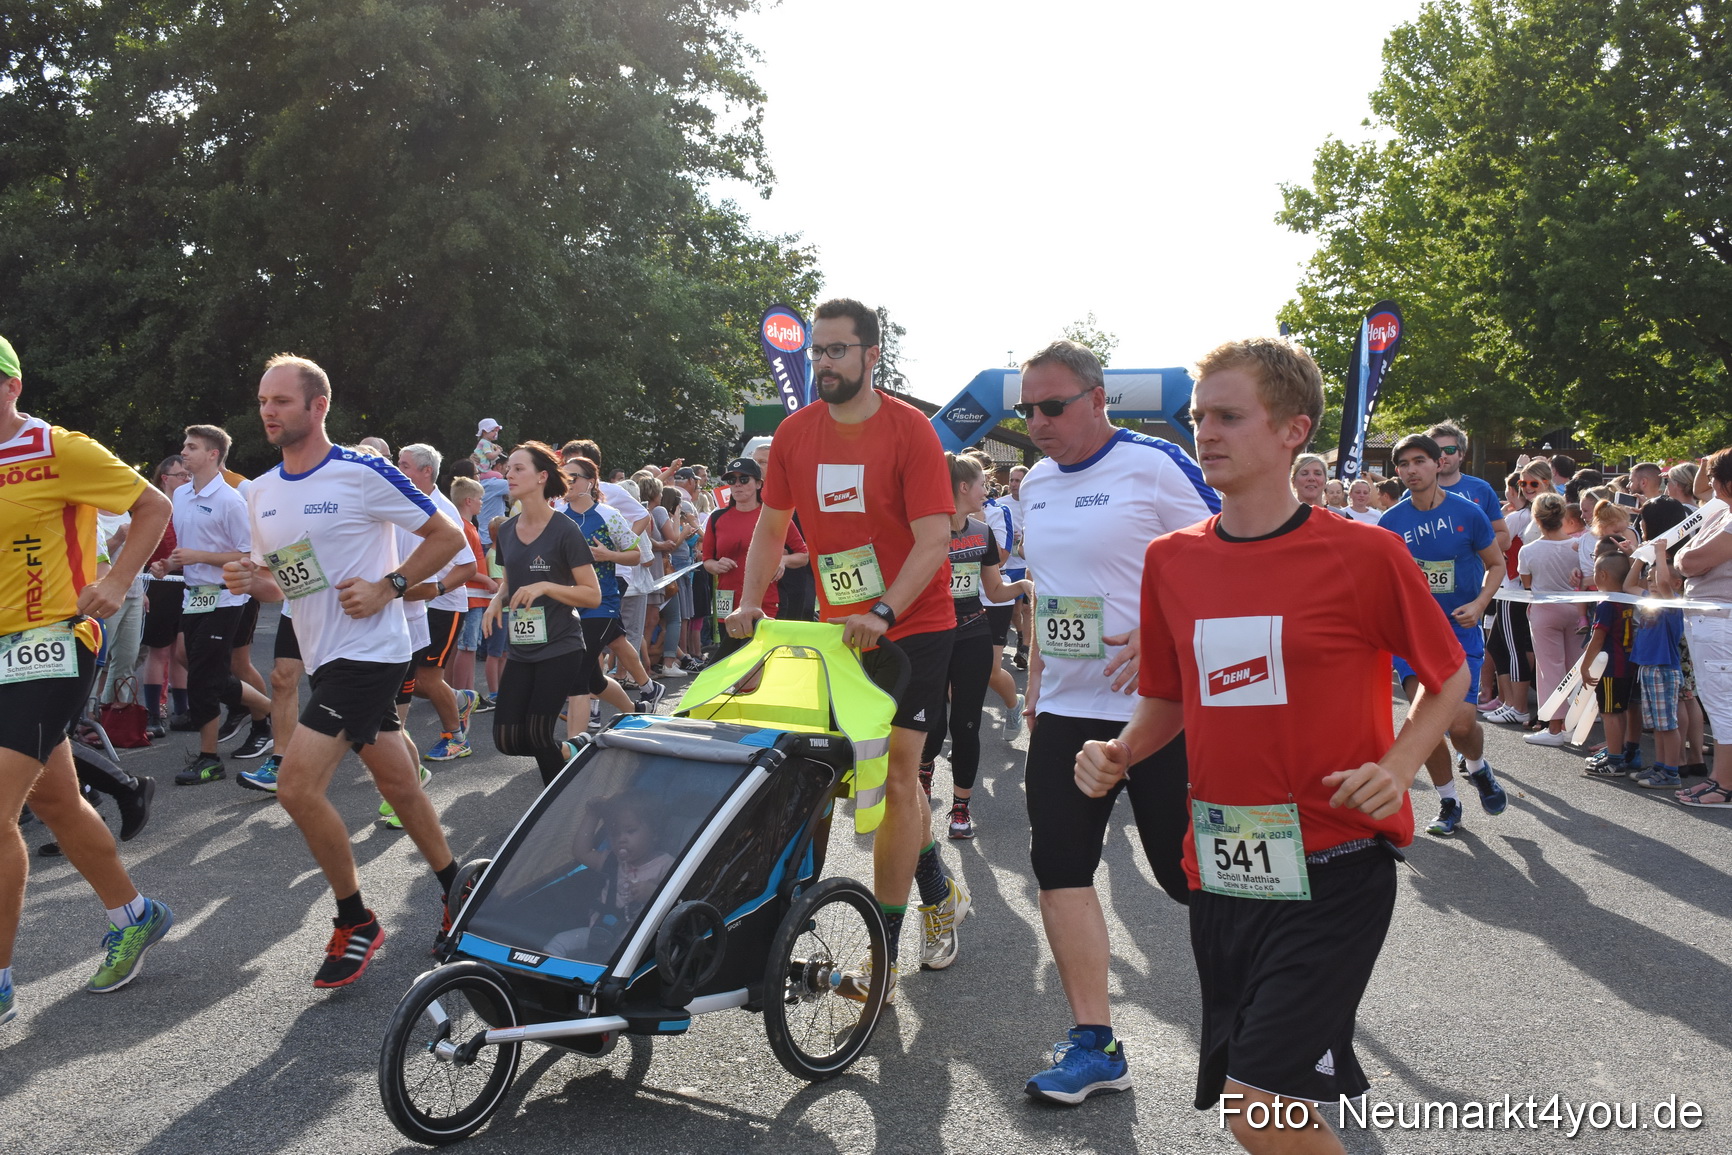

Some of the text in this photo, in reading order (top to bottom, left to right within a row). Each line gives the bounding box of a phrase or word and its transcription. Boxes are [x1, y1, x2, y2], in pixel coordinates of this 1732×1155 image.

[1105, 392, 1123, 405] auf
[952, 412, 984, 421] Fischer
[1030, 501, 1047, 511] JAKO
[261, 509, 277, 519] JAKO
[278, 561, 310, 587] 935
[830, 567, 864, 592] 501
[190, 595, 216, 607] 2390
[513, 621, 535, 635] 425
[1047, 618, 1086, 642] 933
[3, 641, 65, 668] 1669
[6, 662, 64, 674] Schmid Christian
[1222, 668, 1251, 686] DEHN
[809, 738, 829, 748] THULE
[1269, 830, 1293, 840] 2019
[1214, 837, 1272, 874] 541
[1217, 870, 1280, 884] Schöll Matthias
[1223, 881, 1239, 889] DEHN
[727, 920, 742, 932] SPORT
[512, 951, 541, 965] THULE
